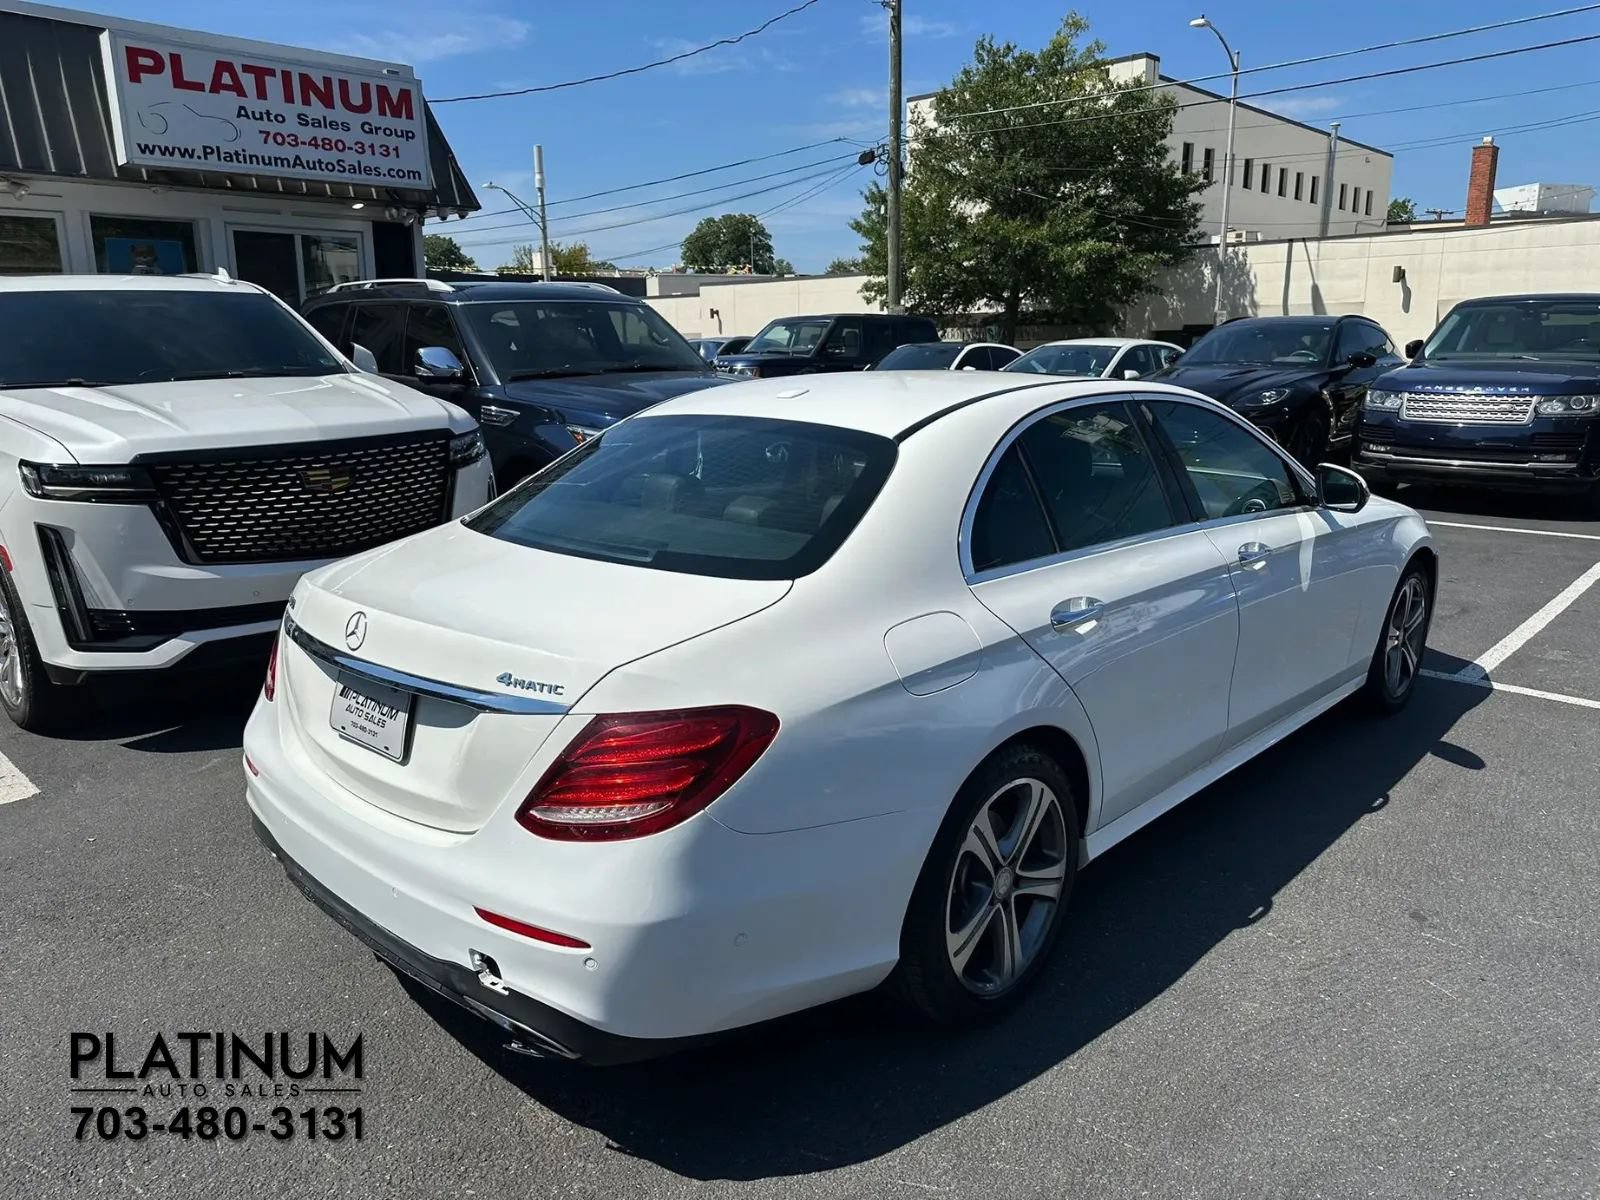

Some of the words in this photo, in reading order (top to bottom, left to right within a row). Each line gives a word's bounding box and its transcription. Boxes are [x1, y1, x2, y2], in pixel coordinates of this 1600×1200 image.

[125, 45, 414, 121] PLATINUM
[236, 105, 286, 125] Auto
[296, 113, 351, 132] Sales
[360, 121, 416, 142] Group
[136, 142, 422, 180] www.PlatinumAutoSales.com
[258, 130, 401, 159] 703-480-3131
[496, 672, 565, 696] 4MATIC
[345, 704, 364, 718] AUTO
[364, 712, 387, 729] SALES
[347, 688, 400, 722] PLATINUM
